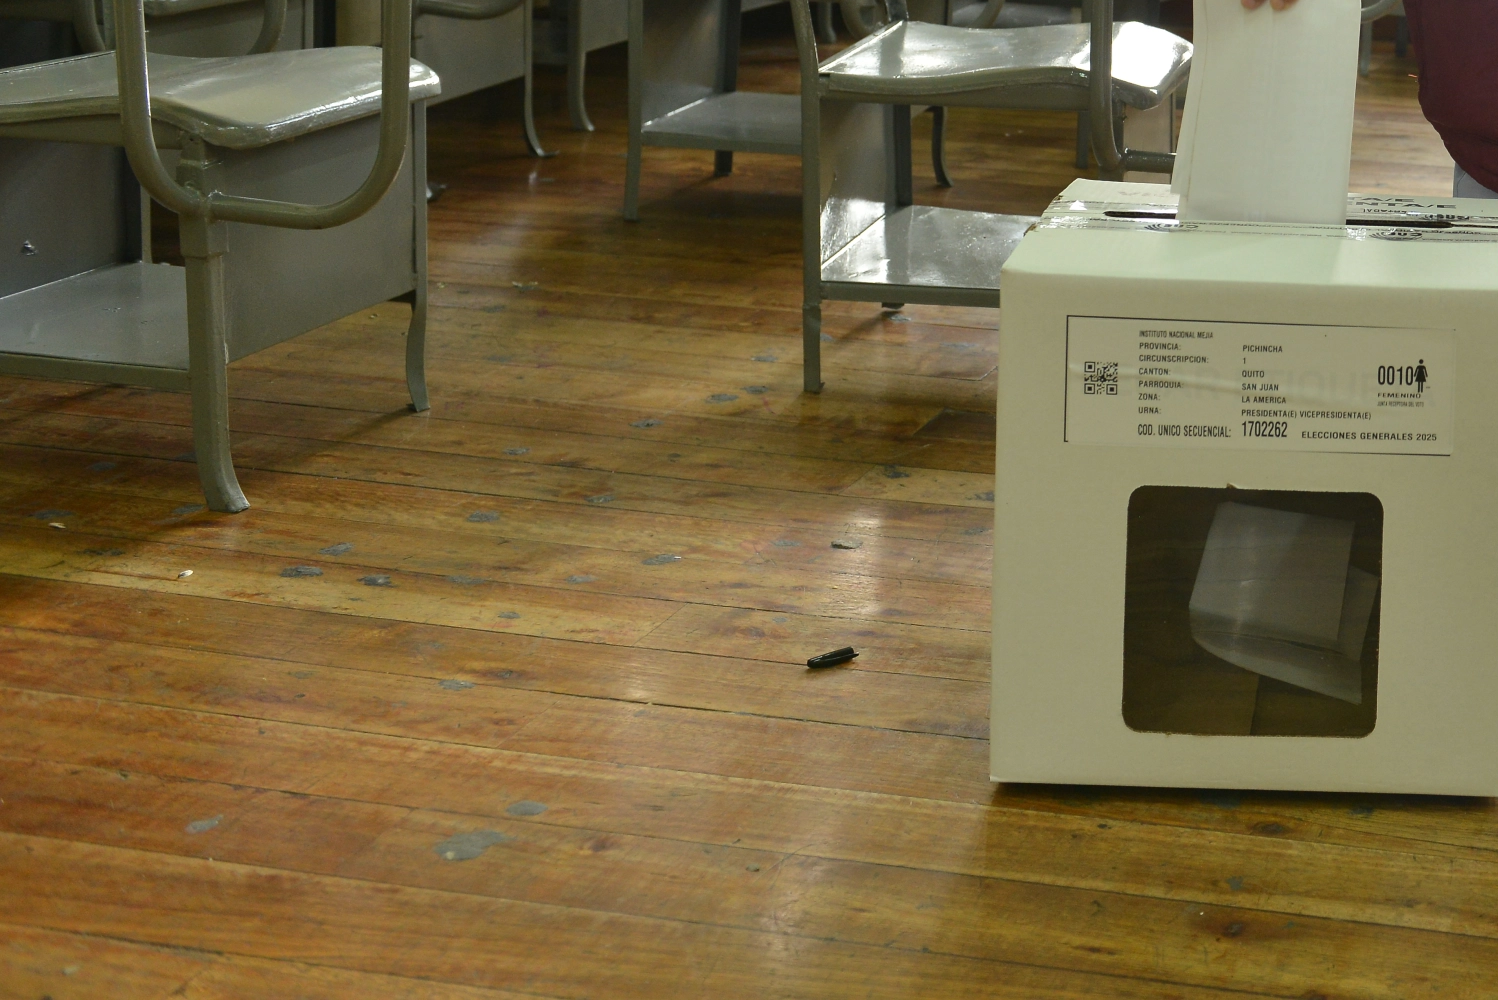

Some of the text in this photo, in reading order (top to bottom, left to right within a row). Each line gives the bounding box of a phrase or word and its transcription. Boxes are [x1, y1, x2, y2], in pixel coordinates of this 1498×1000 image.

[1139, 330, 1167, 338] INSTITUTO
[1169, 331, 1195, 339] NACIONAL
[1139, 342, 1181, 350] PROVINCIA:
[1242, 345, 1283, 353] PICHINCHA
[1138, 355, 1209, 363] CIRCUNSCRIPCION:
[1138, 367, 1171, 375] CANTON:
[1242, 370, 1264, 378] QUITO
[1377, 365, 1414, 386] 0010
[1138, 380, 1184, 388] PARROQUIA:
[1241, 383, 1257, 391] SAN
[1138, 393, 1160, 401] ZONA:
[1253, 396, 1286, 404] AMERICA
[1241, 409, 1371, 420] PRESIDENTA(E) VICEPRESIDENTA(E)
[1138, 421, 1288, 437] COD. UNICO SECUENCIAL: 1702262
[1301, 431, 1437, 441] ELECCIONES GENERALES 2025
